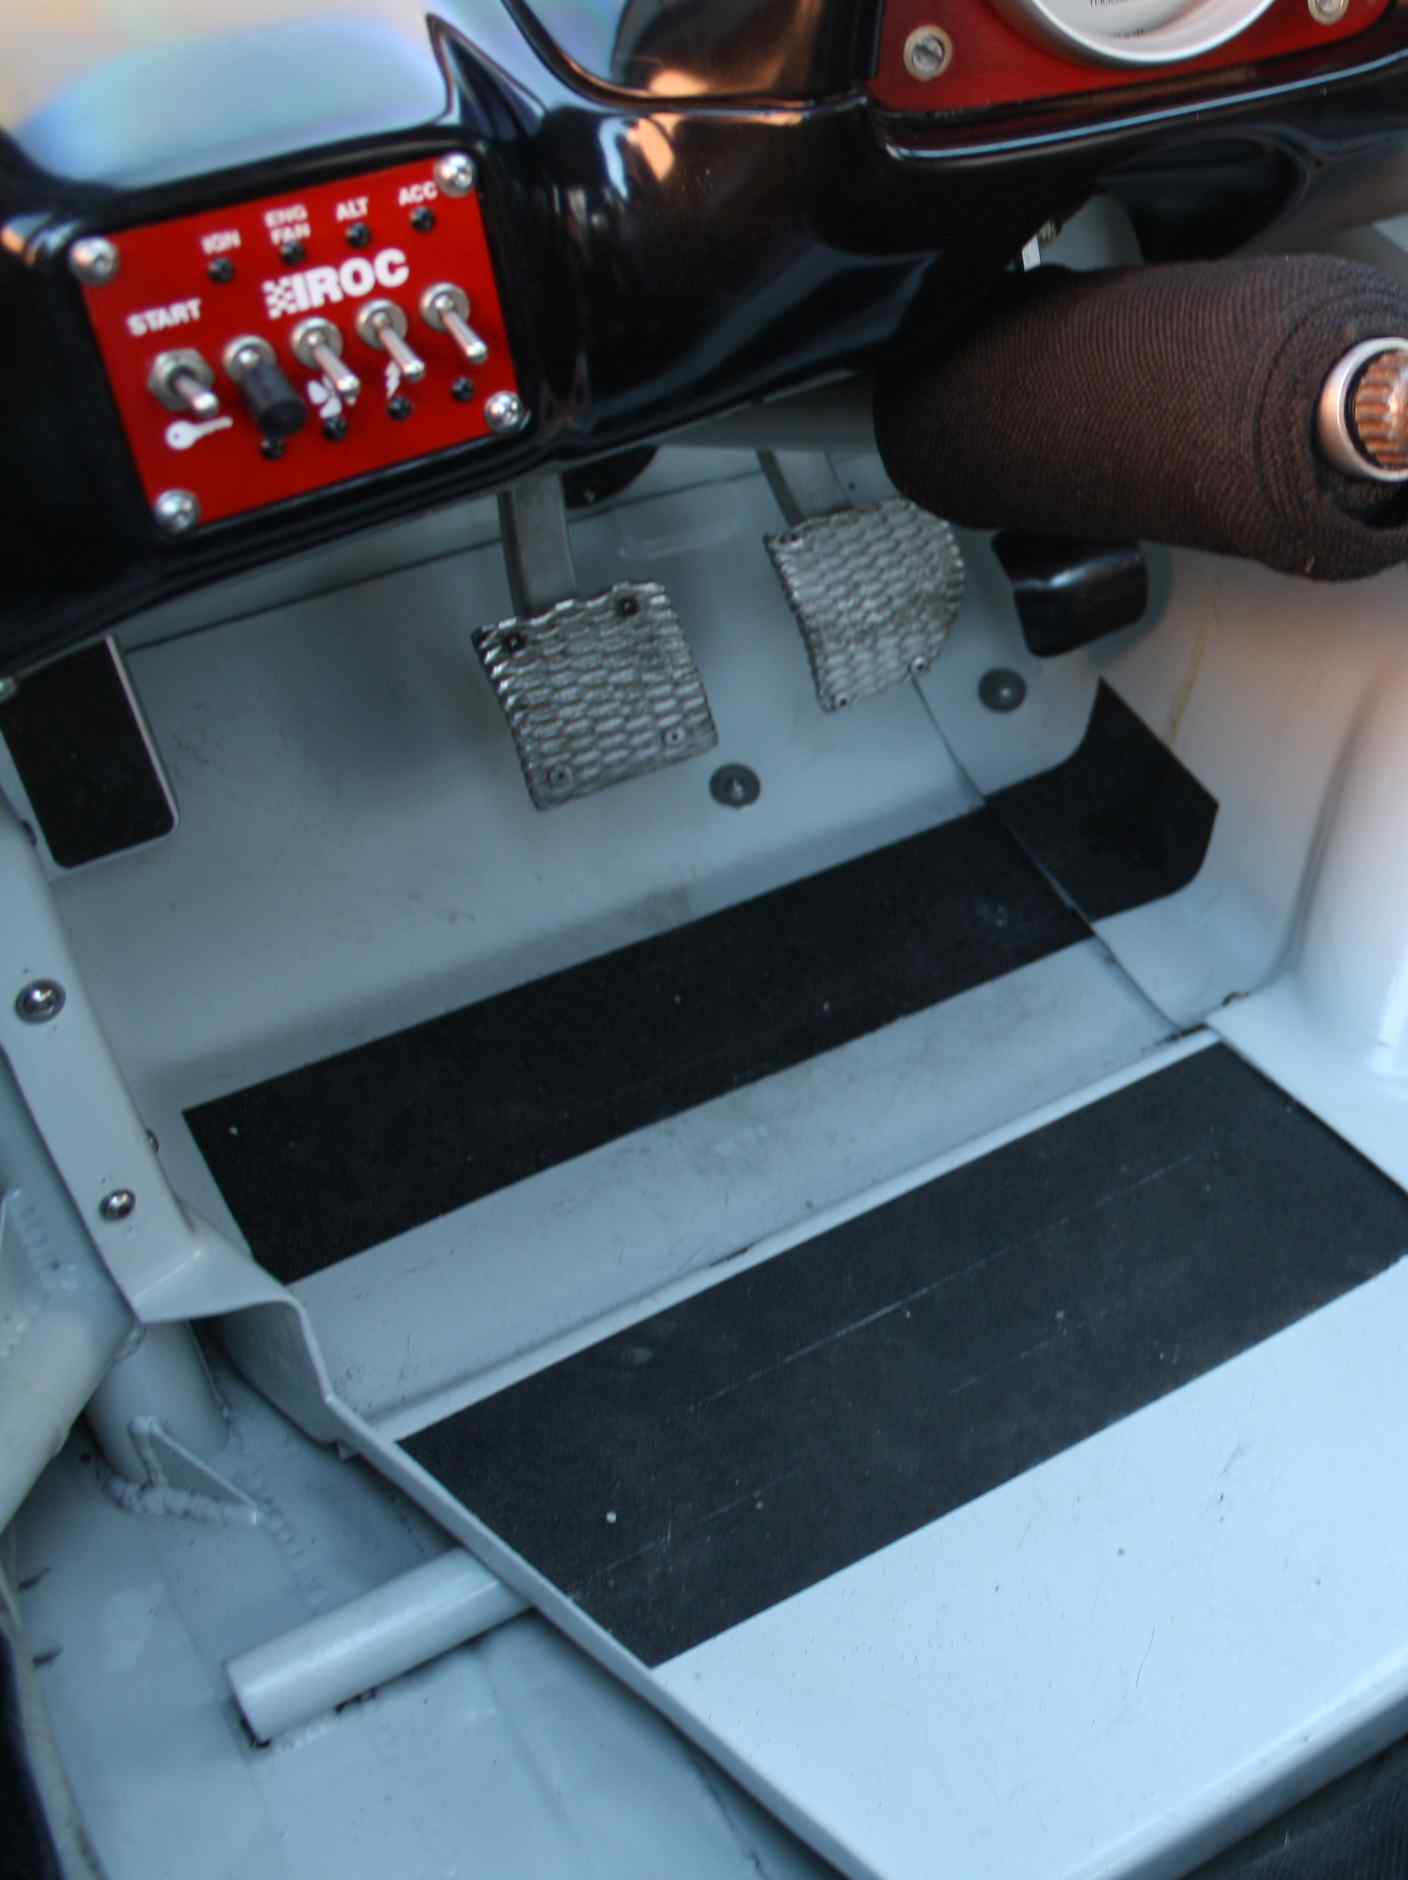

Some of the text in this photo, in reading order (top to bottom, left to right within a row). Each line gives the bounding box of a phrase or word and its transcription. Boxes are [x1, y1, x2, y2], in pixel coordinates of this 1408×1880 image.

[398, 182, 437, 206] ACC
[265, 205, 308, 228] ENG
[336, 197, 369, 221] ALT
[202, 231, 240, 255] IGN
[271, 223, 311, 244] FAN
[293, 248, 409, 310] IROC
[127, 299, 201, 336] START
